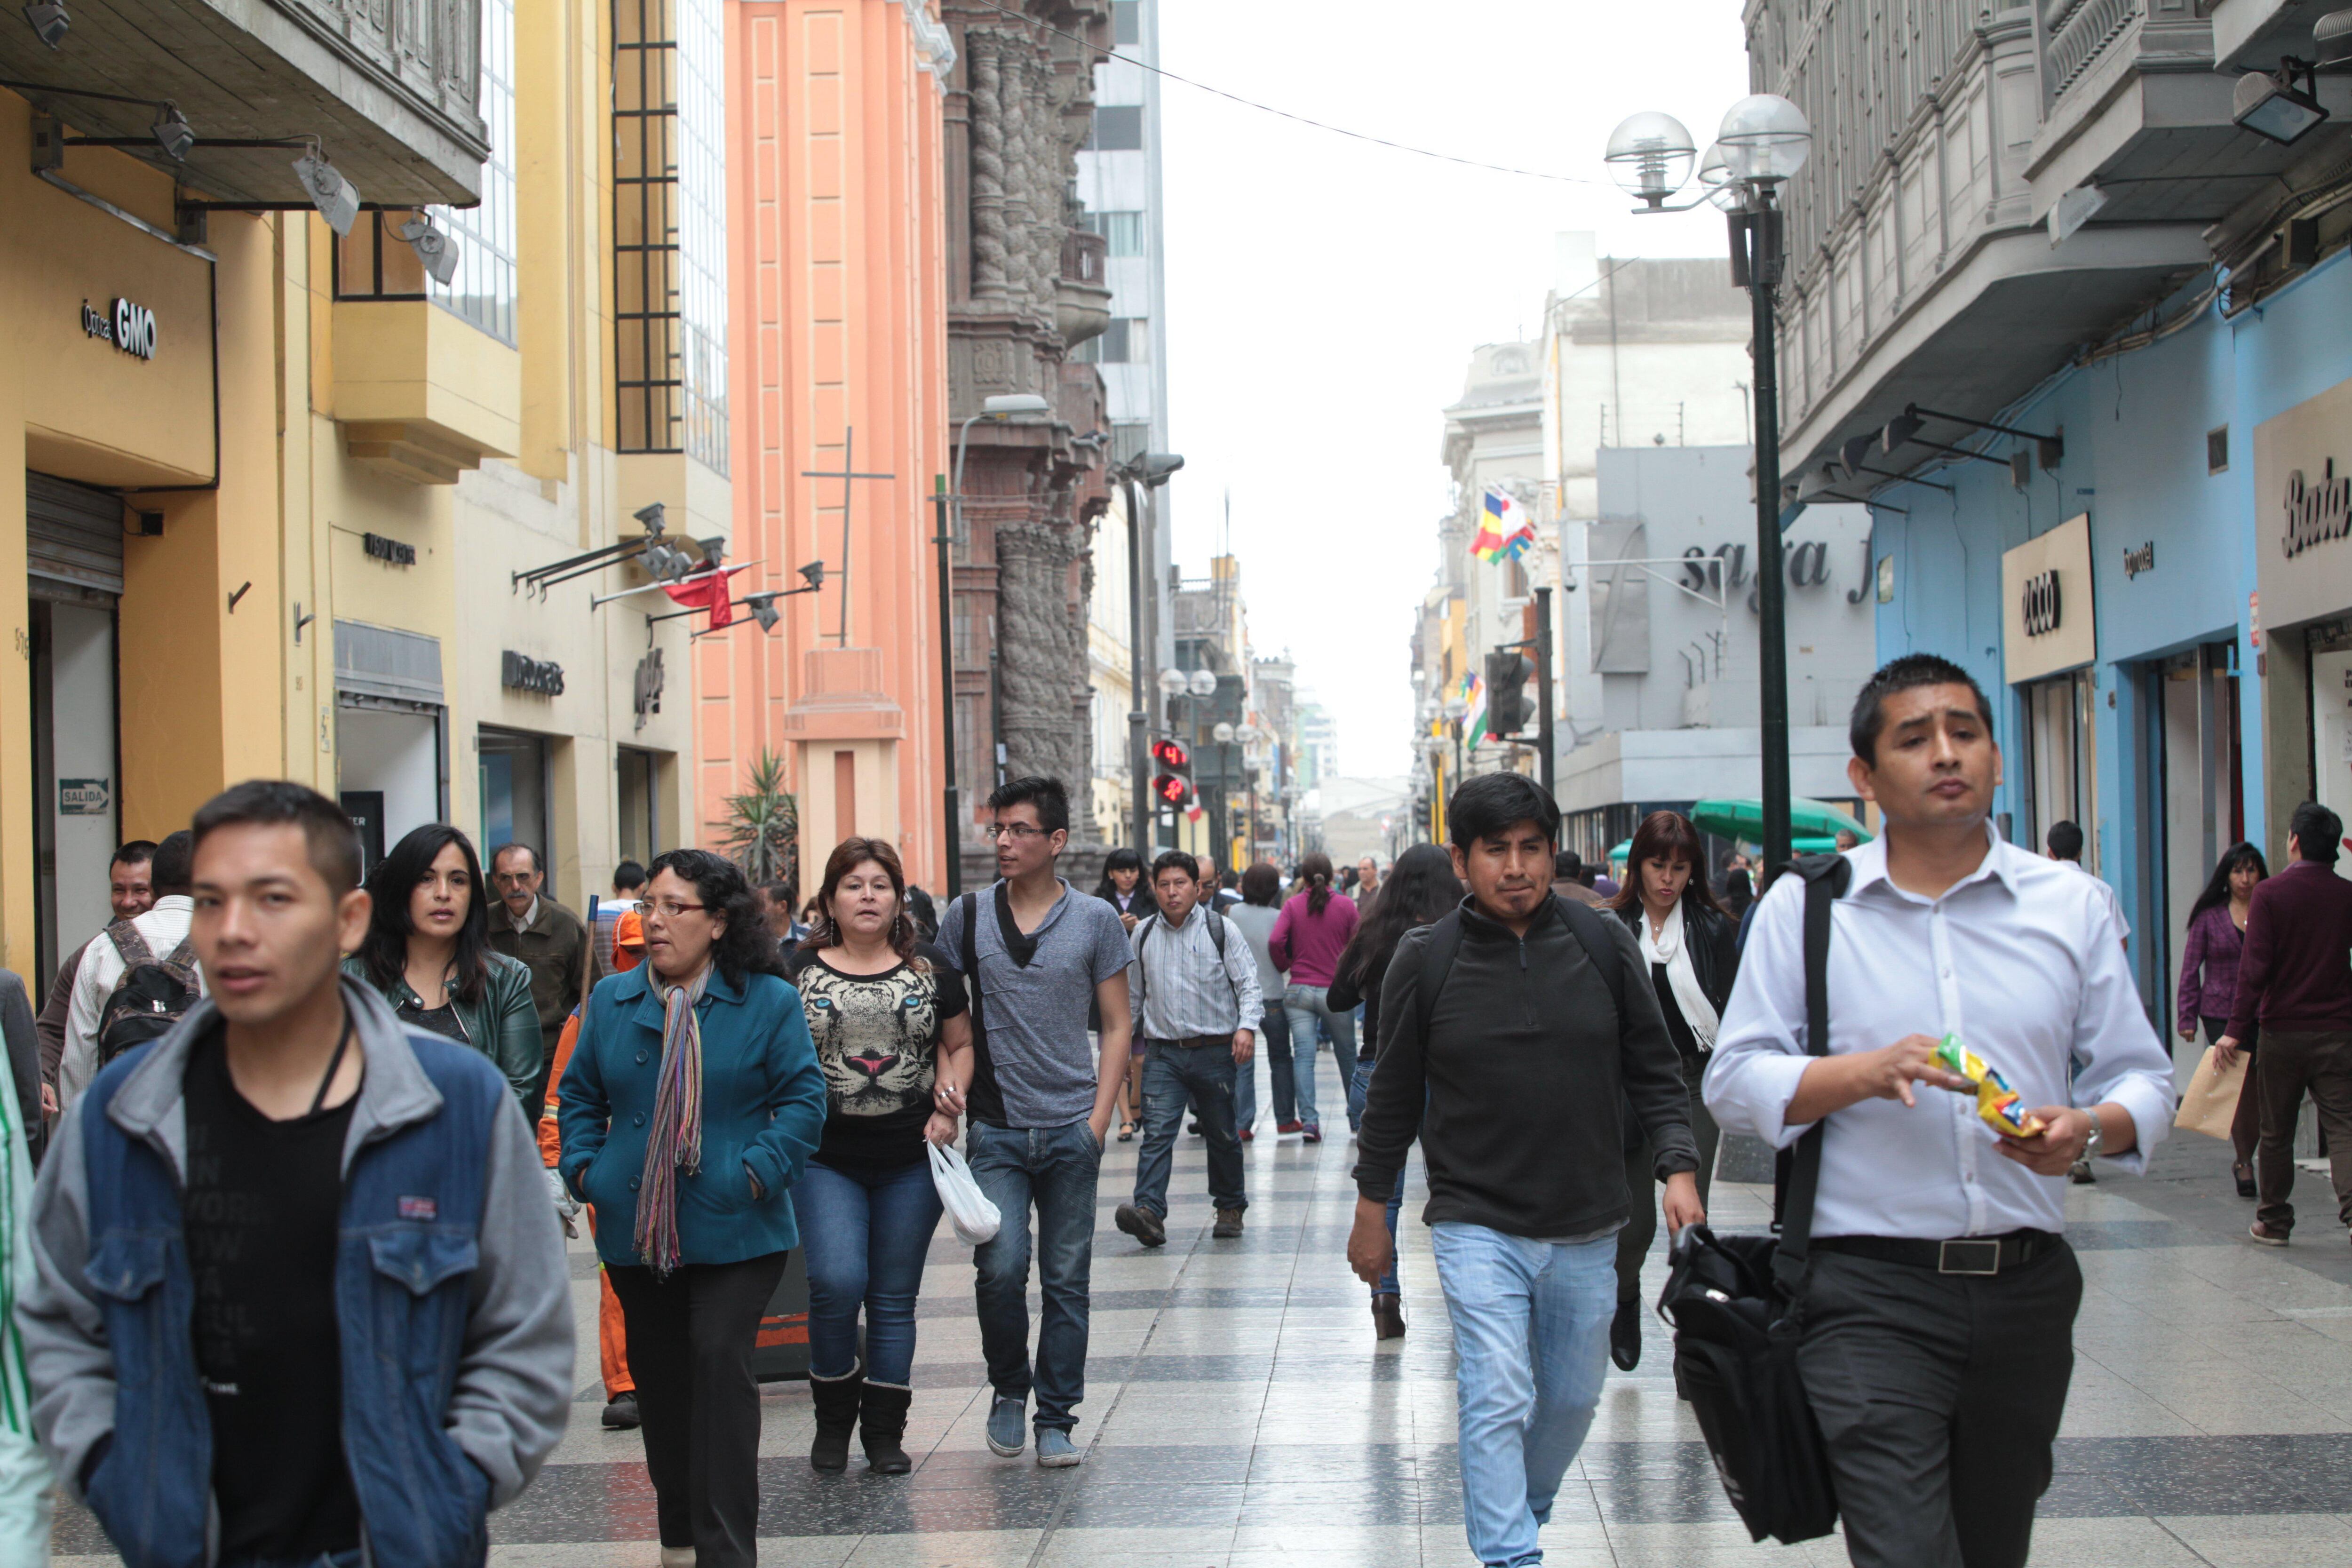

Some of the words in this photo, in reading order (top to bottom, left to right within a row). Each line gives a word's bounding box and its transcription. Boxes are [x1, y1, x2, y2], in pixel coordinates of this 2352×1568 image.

[113, 297, 157, 360] GMO
[2282, 456, 2352, 558] Bata
[2022, 570, 2058, 636] ecco
[64, 792, 102, 802] SALIDA
